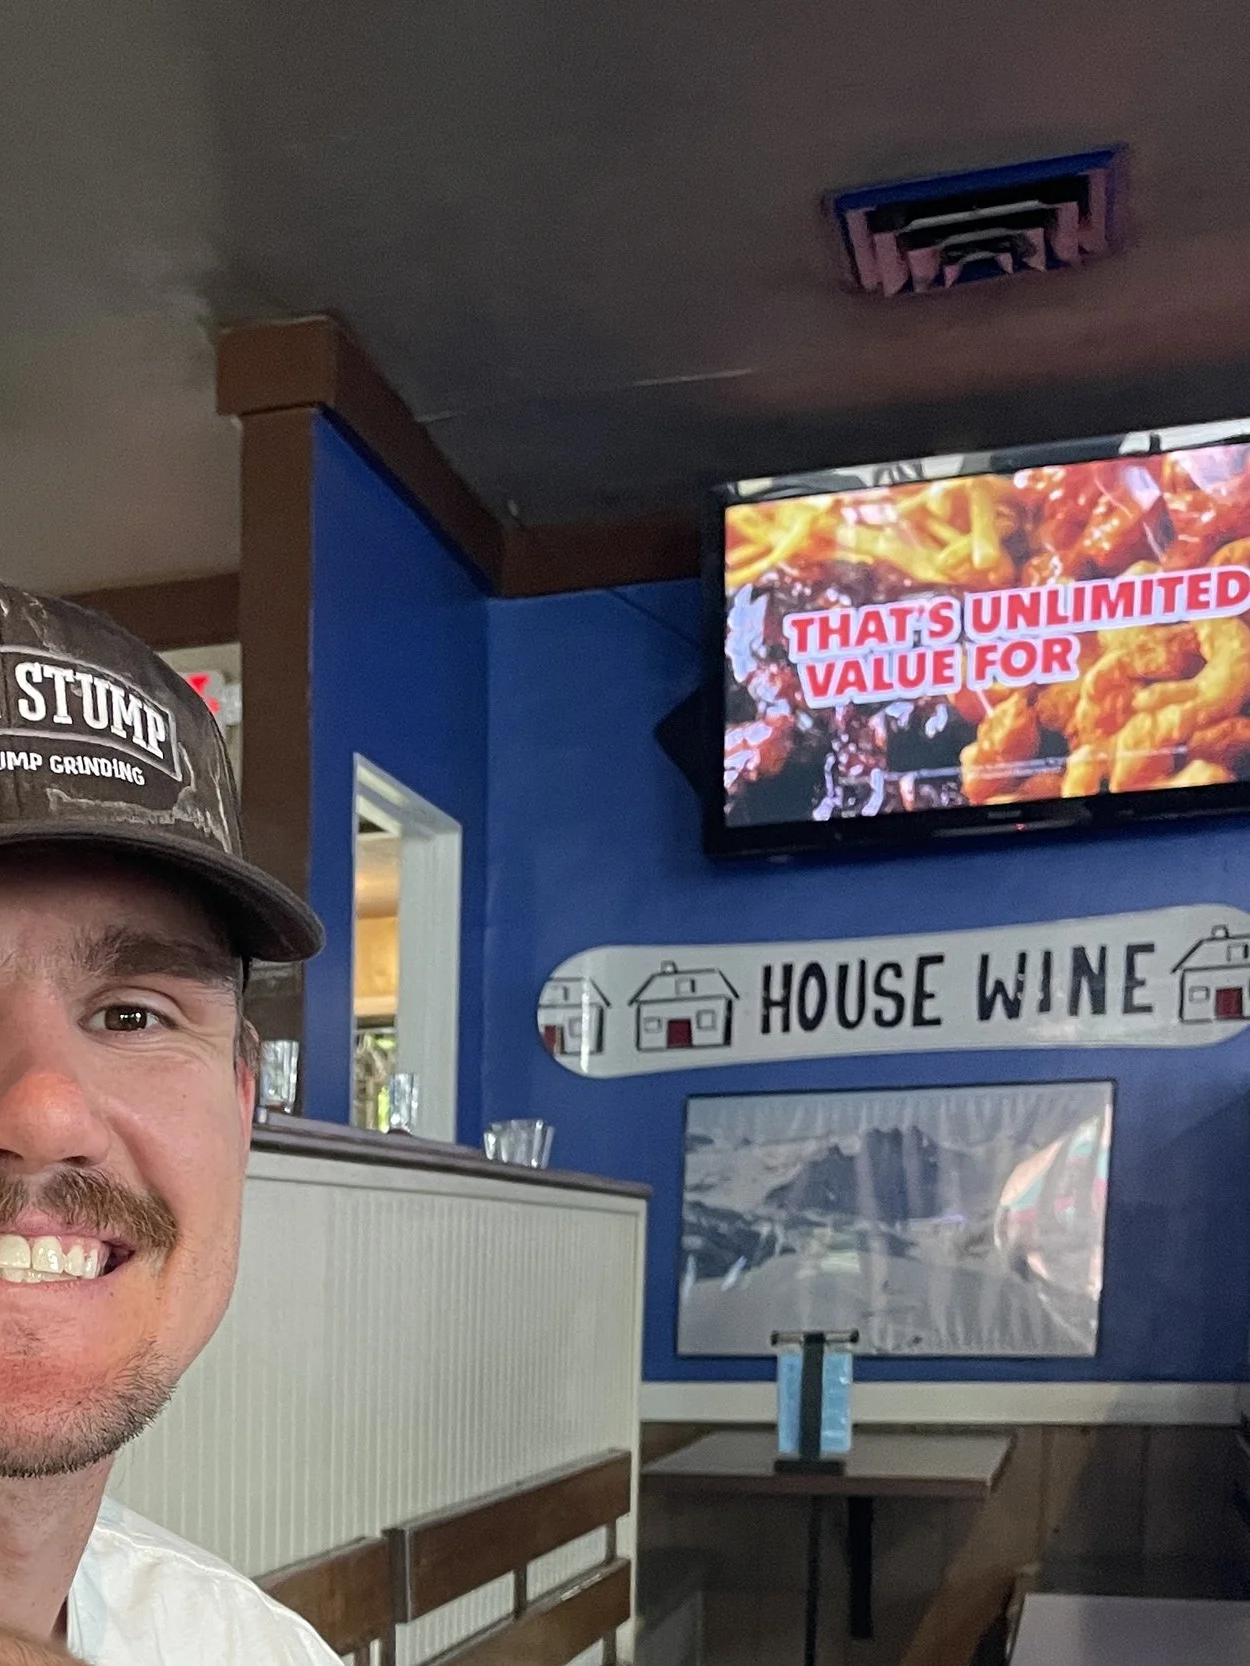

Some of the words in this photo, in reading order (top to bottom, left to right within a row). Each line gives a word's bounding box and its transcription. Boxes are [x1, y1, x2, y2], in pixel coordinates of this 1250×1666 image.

[790, 599, 955, 654] THAT'S
[970, 569, 1250, 634] UNLIMITED
[805, 647, 955, 698] VALUE
[974, 636, 1075, 682] FOR
[14, 661, 166, 759] STUMP
[49, 755, 146, 786] GRINDING
[760, 954, 945, 1035] HOUSE
[977, 943, 1156, 1022] WINE
